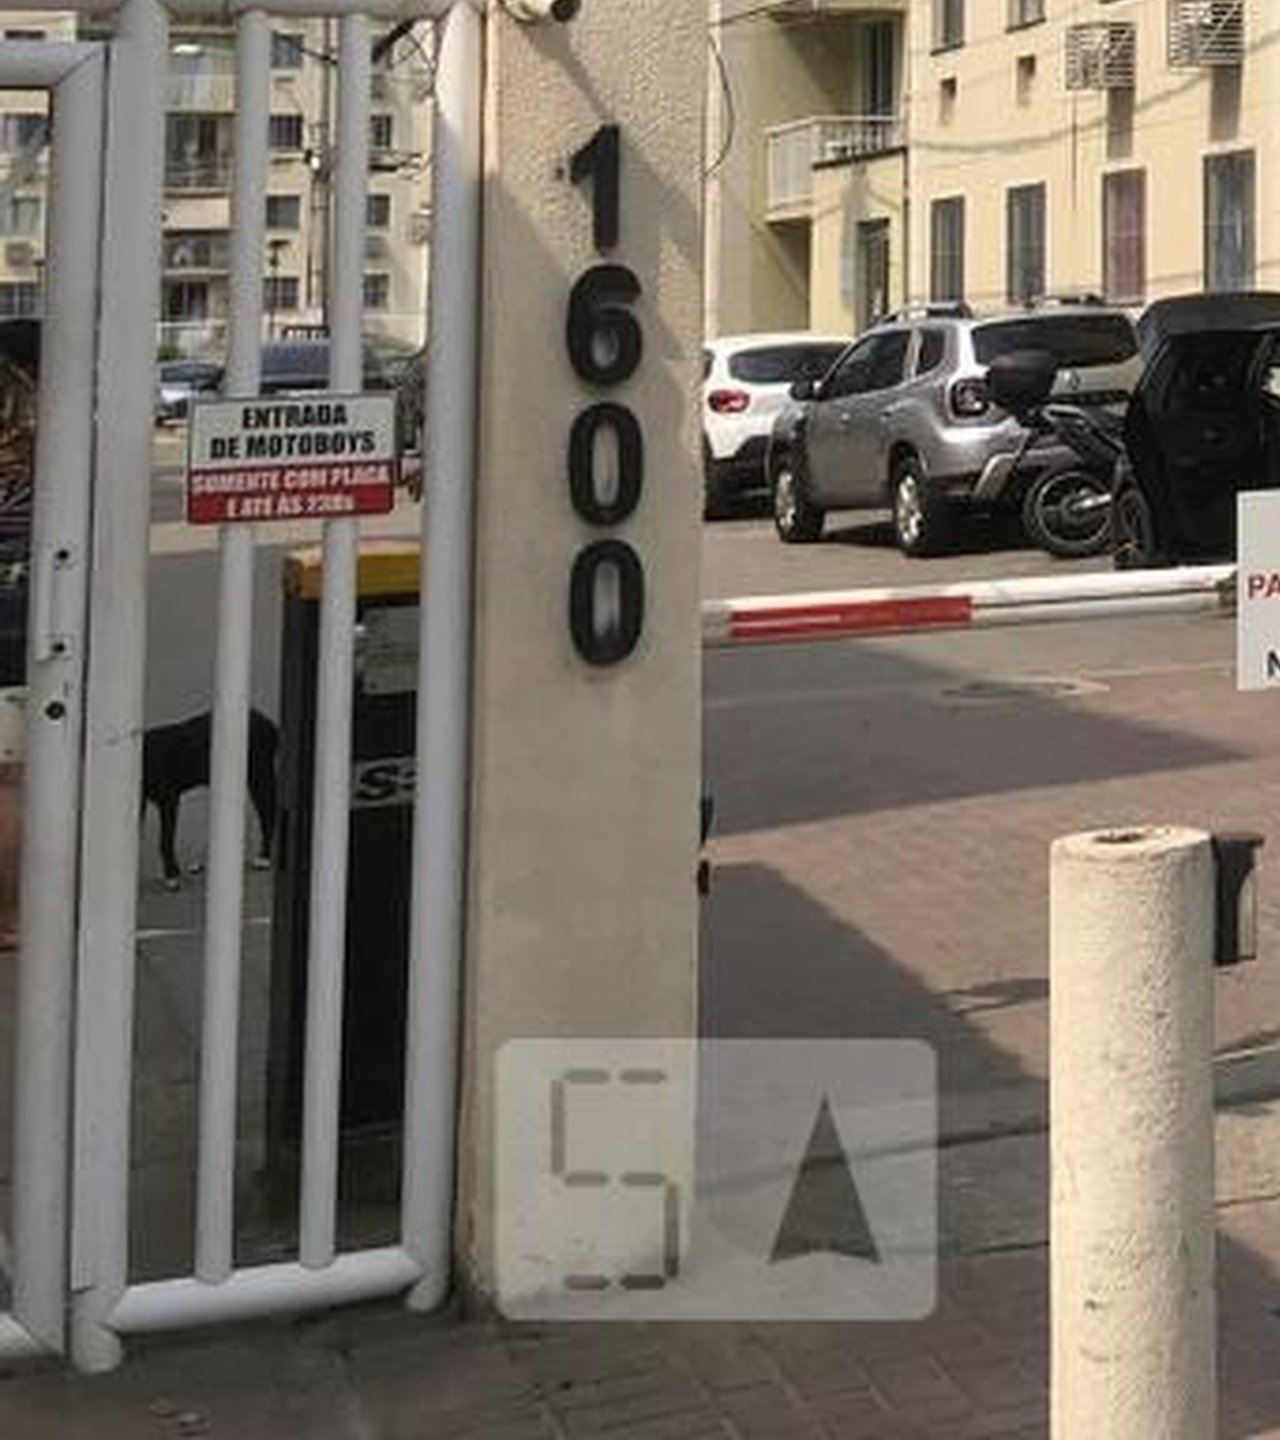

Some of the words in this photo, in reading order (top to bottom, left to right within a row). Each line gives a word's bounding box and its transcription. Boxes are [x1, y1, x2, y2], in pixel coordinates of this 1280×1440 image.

[566, 123, 644, 668] 1600
[243, 404, 347, 429] ENTRADA
[210, 437, 241, 458] DE
[246, 431, 376, 457] MOTOBOYS
